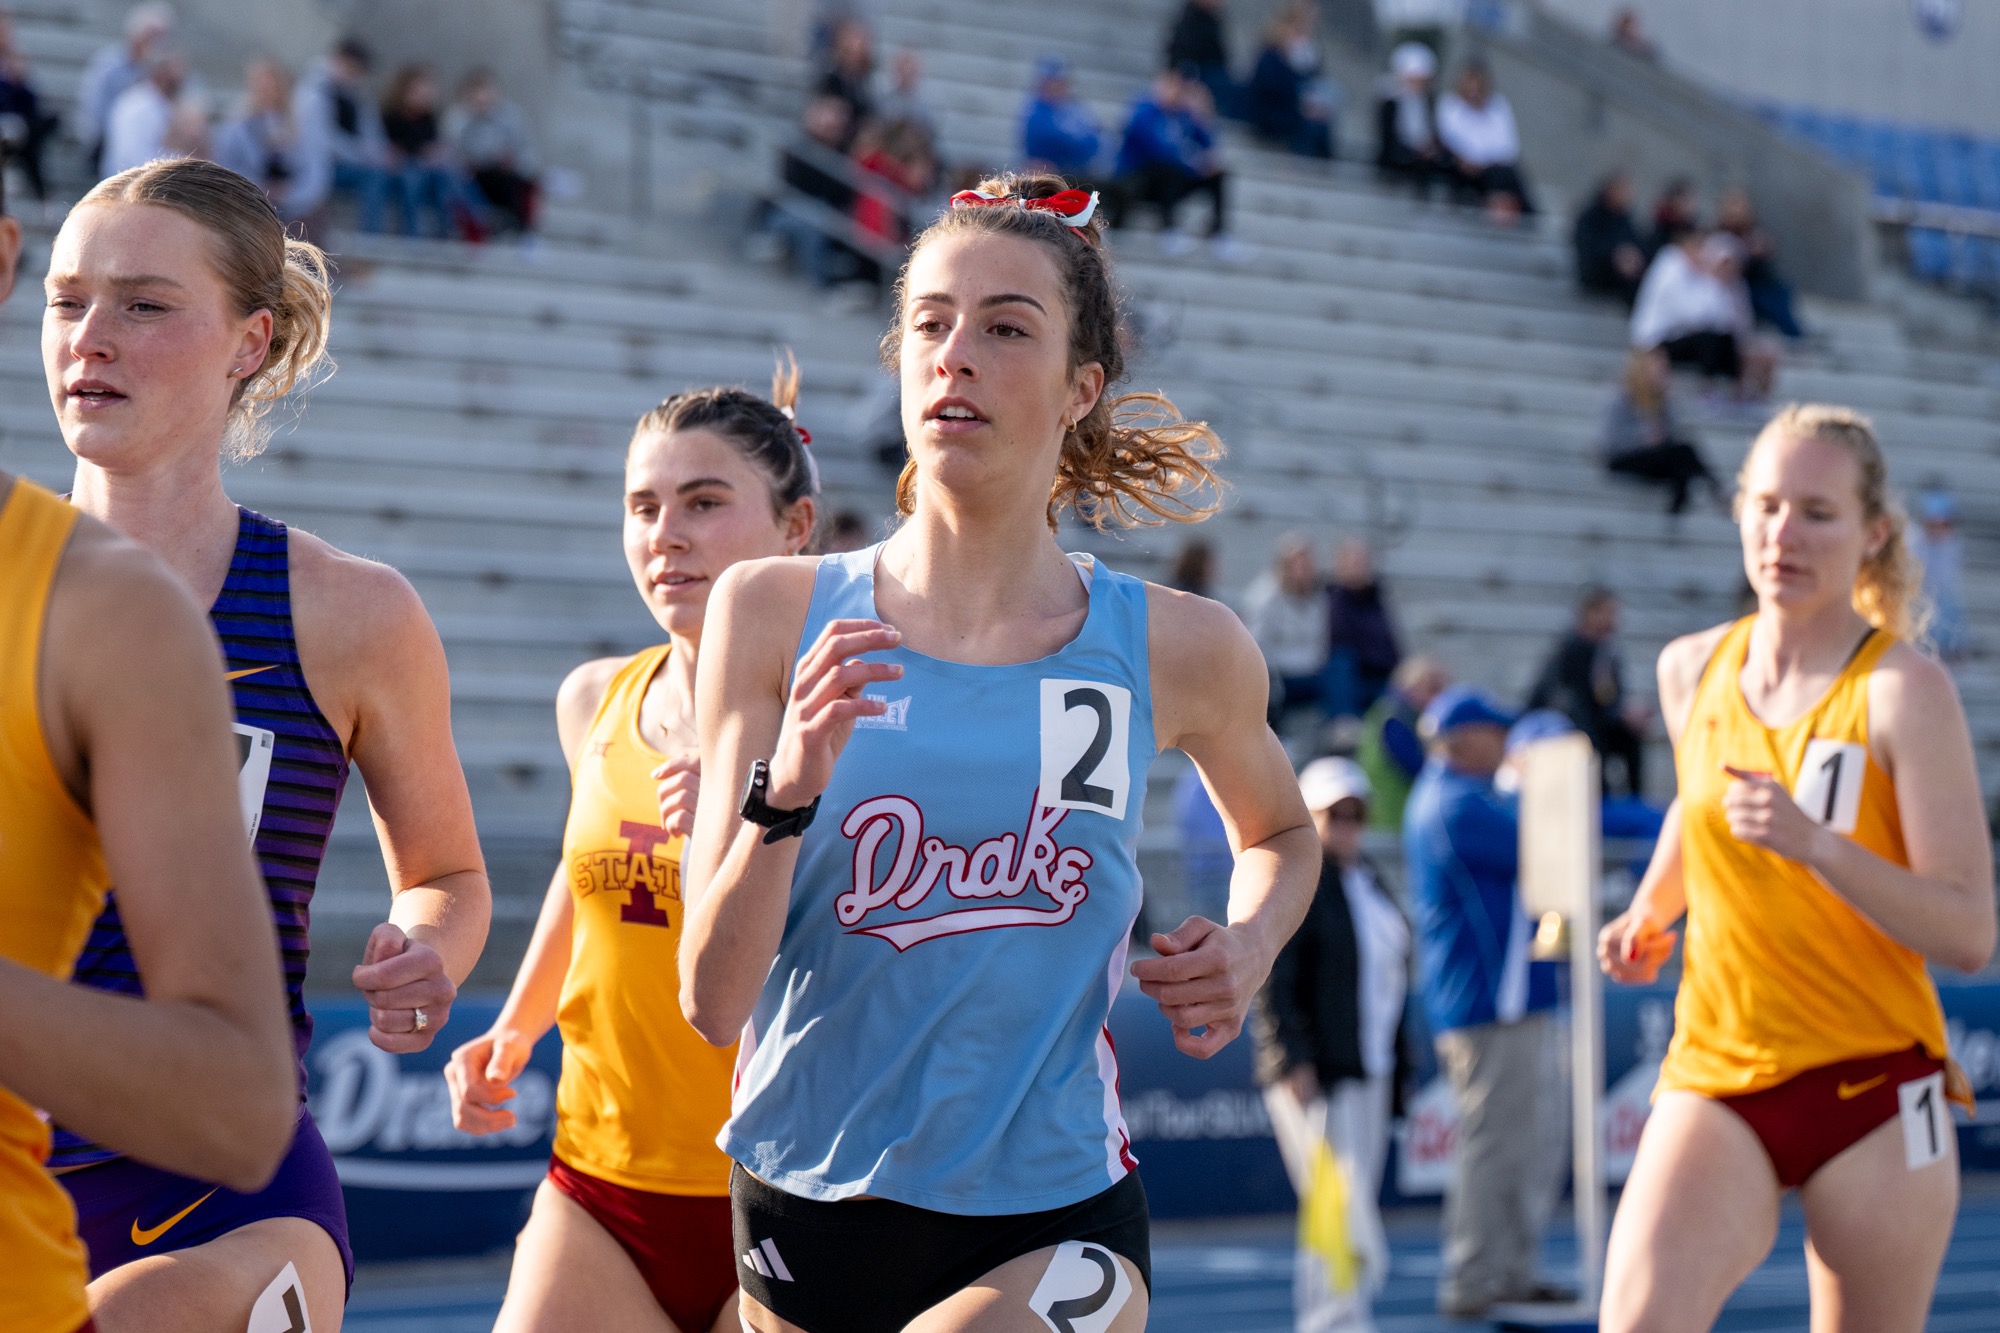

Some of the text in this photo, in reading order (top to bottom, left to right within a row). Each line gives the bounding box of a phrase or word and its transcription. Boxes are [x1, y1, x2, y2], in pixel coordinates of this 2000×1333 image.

[1061, 687, 1113, 809] 2
[1820, 751, 1843, 822] 1
[573, 850, 682, 901] STAT
[834, 784, 1094, 928] Drake
[1915, 1086, 1938, 1156] 1
[1046, 1246, 1117, 1333] 2
